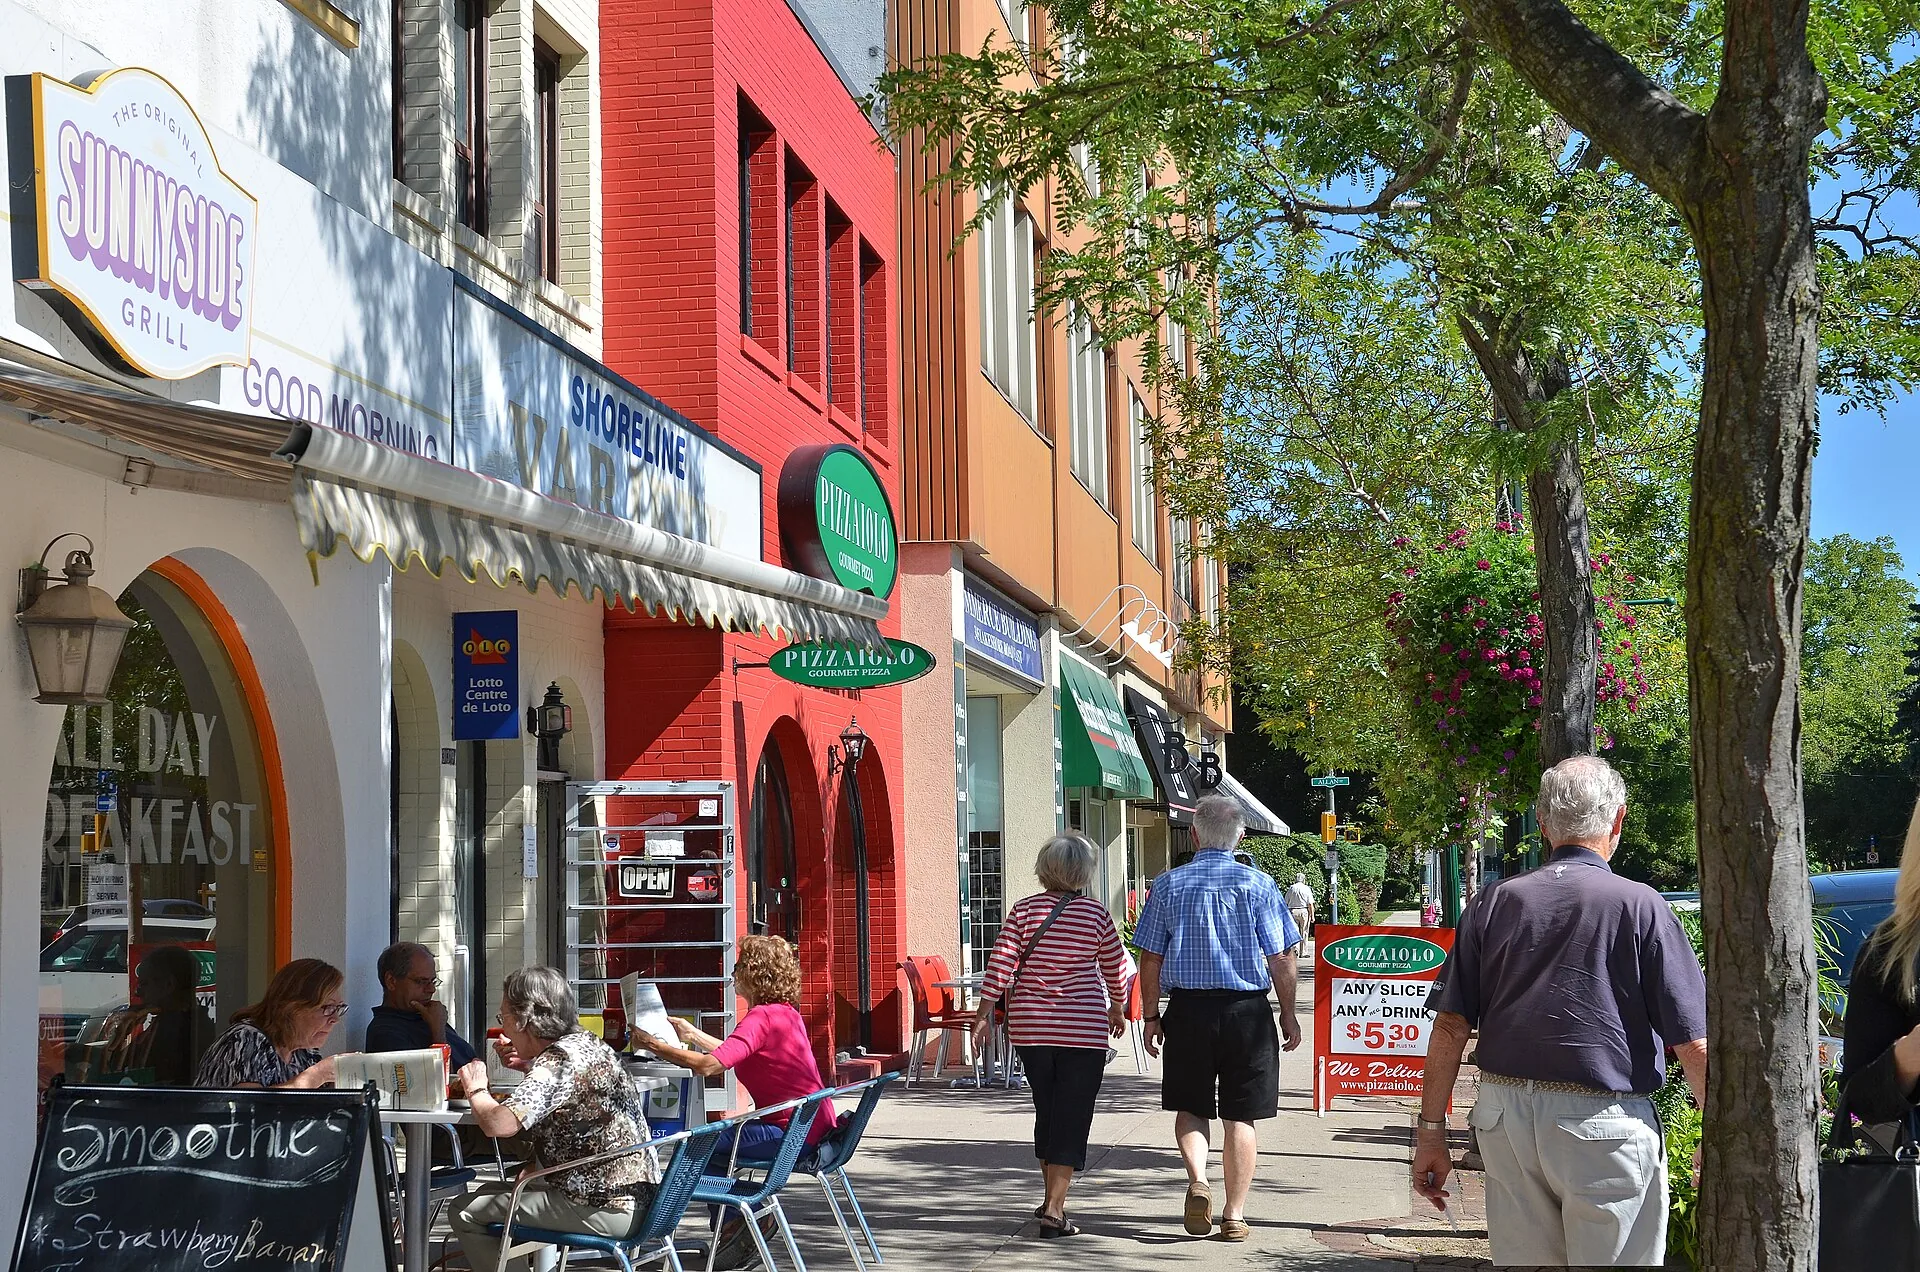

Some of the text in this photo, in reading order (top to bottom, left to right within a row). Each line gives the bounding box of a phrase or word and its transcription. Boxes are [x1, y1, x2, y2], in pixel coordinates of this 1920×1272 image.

[112, 102, 203, 179] THE ORIGINAL
[58, 120, 243, 331] SUNNYSIDE
[122, 297, 188, 351] GRILL
[243, 358, 438, 461] GOOD MORNING
[571, 375, 686, 481] SHORELINE
[820, 475, 889, 564] PIZZAIOLO
[838, 551, 874, 583] GOURMET PIZZA
[464, 641, 508, 654] OLG
[470, 677, 504, 688] Lotto
[808, 668, 891, 678] GOURMET PIZZA
[465, 689, 508, 700] Centre
[462, 702, 511, 713] de Loto
[139, 707, 217, 777] DAY
[45, 793, 257, 866] REAKFAST
[623, 866, 670, 891] OPEN
[96, 892, 119, 901] SERVER
[1334, 947, 1435, 962] PIZZAIOLO
[1343, 983, 1376, 995] ANY
[1380, 984, 1426, 996] SLICE
[1336, 1005, 1368, 1017] ANY
[1382, 1006, 1432, 1019] DRINK
[1346, 1022, 1420, 1049] $5.30
[1328, 1060, 1424, 1079] We Delive
[652, 1129, 667, 1137] EST.
